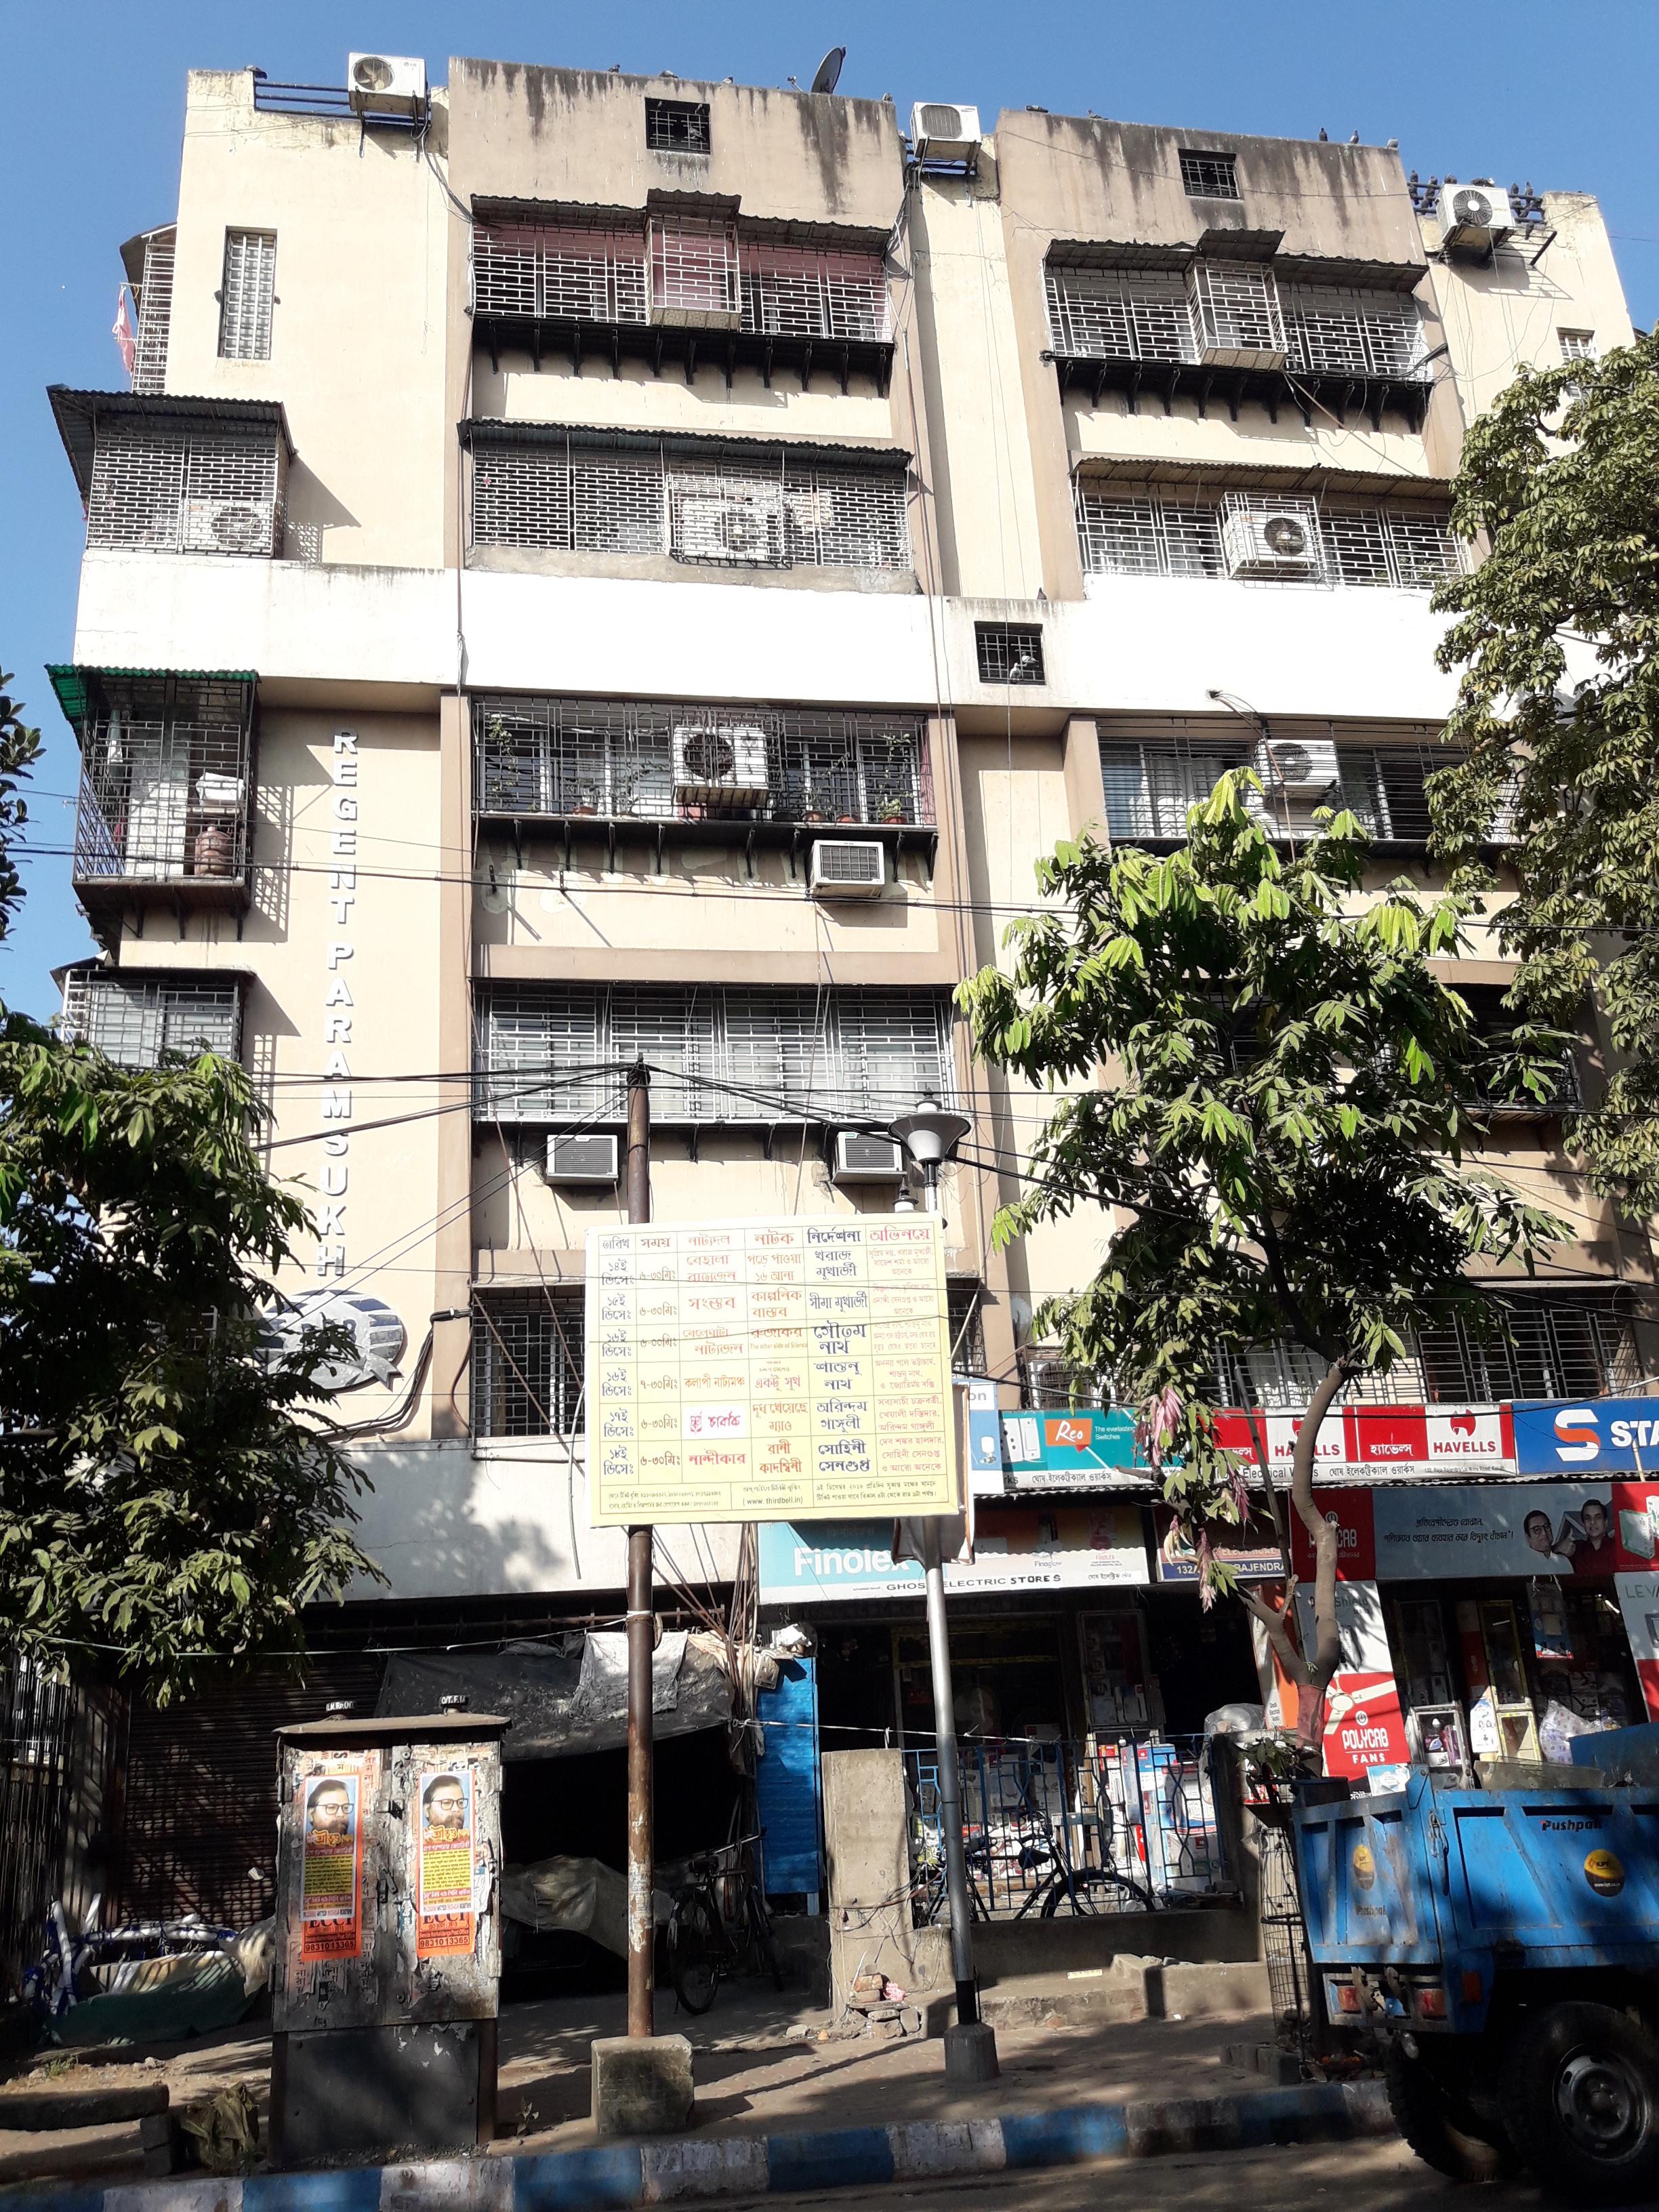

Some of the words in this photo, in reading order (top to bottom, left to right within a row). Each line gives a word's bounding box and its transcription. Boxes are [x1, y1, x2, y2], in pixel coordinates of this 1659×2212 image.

[330, 730, 358, 924] REGENT
[317, 942, 354, 1277] PARAMSUKH
[754, 1229, 794, 1245] নাটক
[807, 1227, 861, 1243] নির্দেশনা
[870, 1225, 930, 1241] অভিনয়ে
[603, 1236, 630, 1249] তারিখ
[641, 1237, 671, 1248] সময়
[687, 1255, 730, 1265] বেহালা
[815, 1250, 851, 1261] খরাজ
[771, 1271, 794, 1281] আনা
[752, 1307, 787, 1317] বাস্তব
[813, 1320, 866, 1338] গৌতম
[819, 1338, 850, 1354] নাথ
[813, 1361, 862, 1375] শান্তনু
[756, 1374, 782, 1391] একটু
[824, 1378, 853, 1390] নাথ
[817, 1397, 867, 1412] অরিন্দম
[1055, 1420, 1083, 1442] Reo
[767, 1439, 792, 1454] রানী
[819, 1439, 867, 1455] সোহিনী
[1275, 1444, 1340, 1456] HALLS
[1433, 1441, 1496, 1453] HAVELLS
[819, 1458, 871, 1471] সেনগুপ্ত
[1032, 1475, 1046, 1483] ঘোষ
[1243, 1467, 1286, 1478] Elecical
[1330, 1467, 1344, 1477] ঘোষ
[886, 1581, 926, 1591] GHOS
[1010, 1574, 1061, 1585] STORES
[1342, 1727, 1389, 1750] POLYCAB
[1352, 1753, 1385, 1764] FANS
